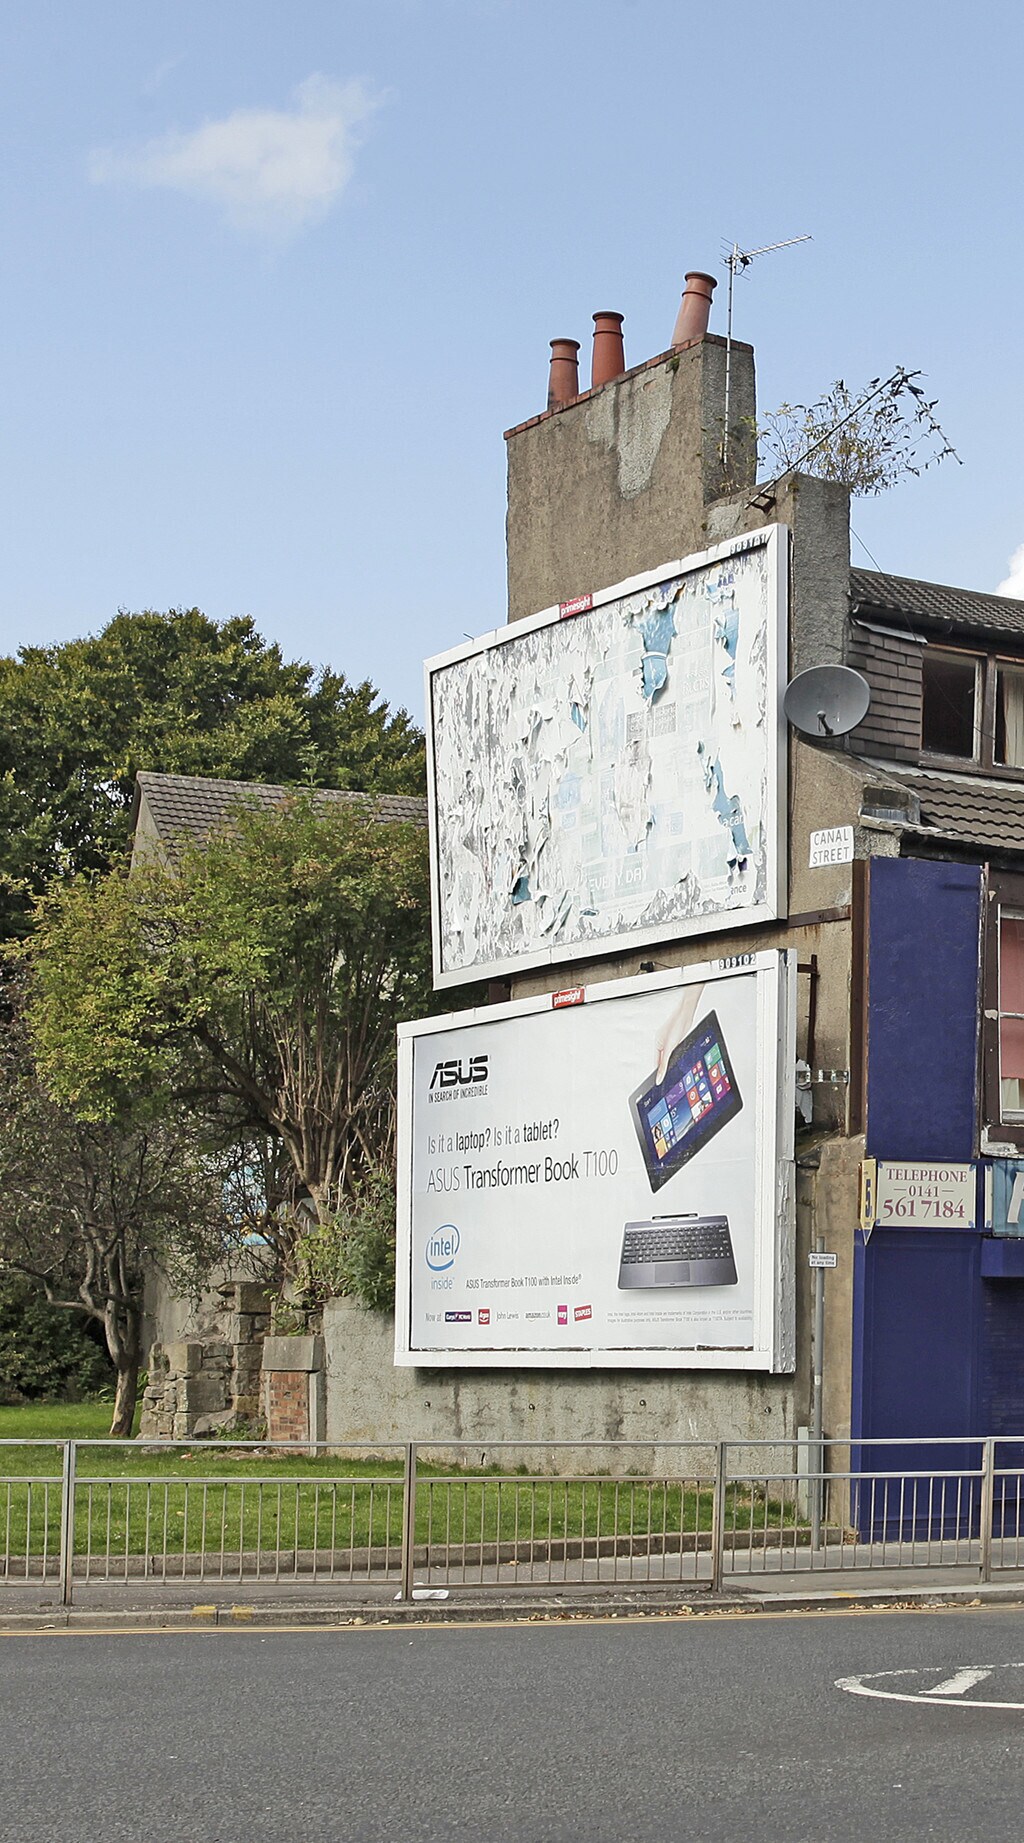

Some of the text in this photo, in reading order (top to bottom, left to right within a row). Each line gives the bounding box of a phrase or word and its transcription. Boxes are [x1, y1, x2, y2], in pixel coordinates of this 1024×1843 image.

[813, 828, 849, 846] CANAL
[812, 846, 849, 865] STREET
[719, 953, 756, 970] 909102
[429, 1054, 489, 1090] ASUS
[428, 1084, 489, 1104] IN SEARCH OF INCREDIBLE
[427, 1118, 560, 1155] Is it a laptop? Is it a tablet?
[426, 1149, 618, 1194] ASUS Transformer Book T100
[886, 1167, 968, 1183] TELEPHONE
[882, 1196, 917, 1219] 561
[920, 1198, 966, 1219] 7184
[430, 1234, 455, 1257] intel
[430, 1276, 454, 1290] inside
[466, 1279, 480, 1290] ASUS
[480, 1277, 510, 1289] Transformer
[511, 1277, 524, 1288] Book
[524, 1276, 537, 1288] T100
[538, 1275, 550, 1287] with
[550, 1274, 563, 1286] Intel
[425, 1312, 436, 1322] Now
[496, 1311, 507, 1322] John
[574, 1308, 592, 1319] STAPLES
